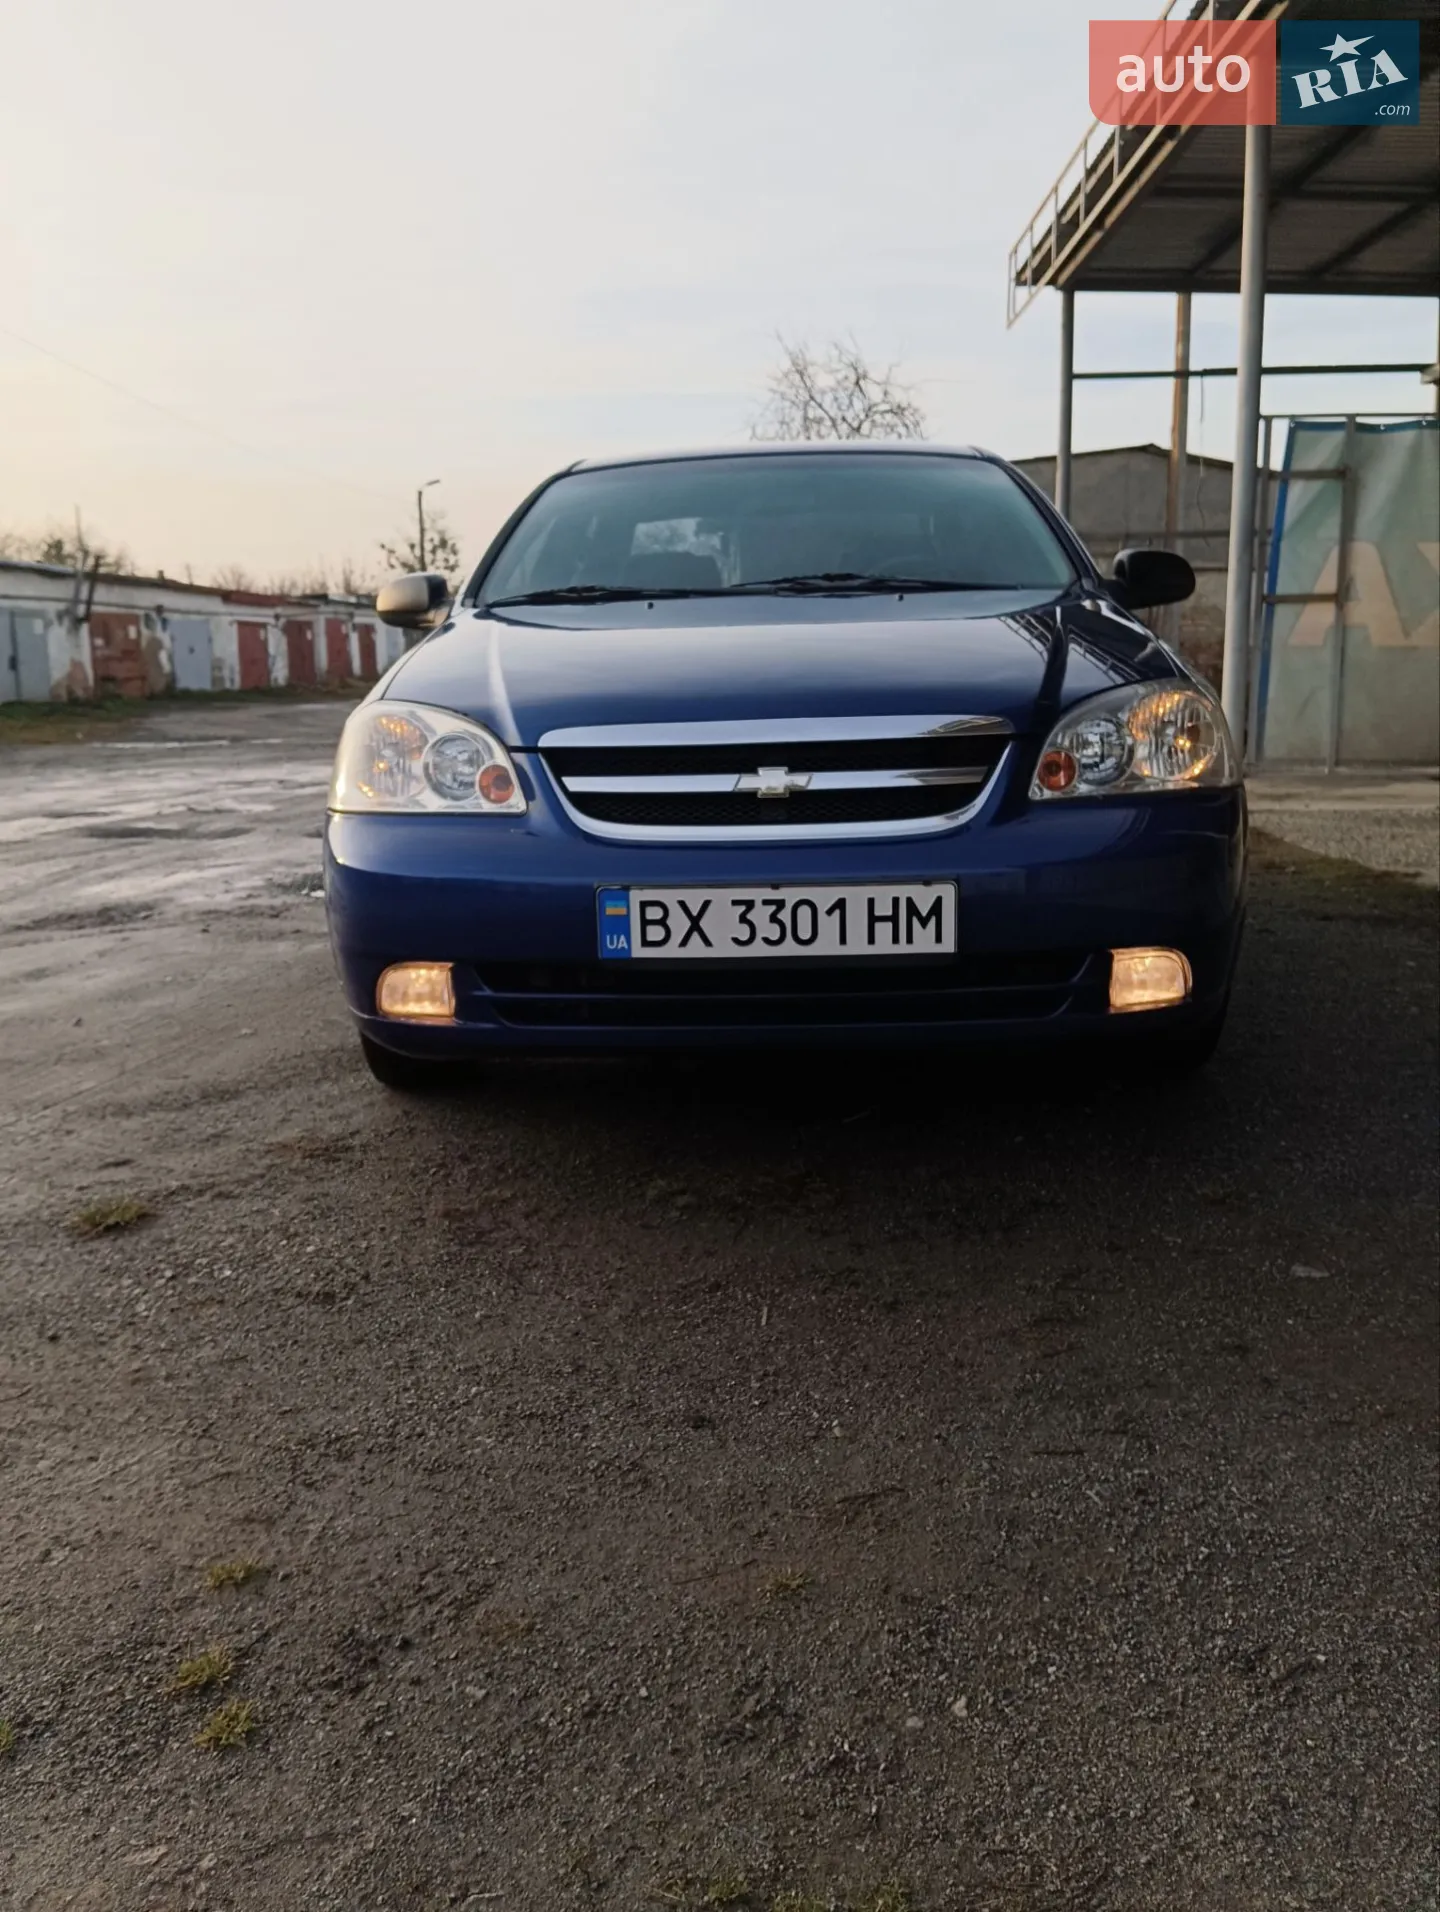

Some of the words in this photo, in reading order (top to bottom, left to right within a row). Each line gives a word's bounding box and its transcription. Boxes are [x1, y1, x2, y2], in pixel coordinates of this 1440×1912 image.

[639, 899, 714, 948] BX
[730, 897, 847, 946] 3301
[867, 895, 943, 945] HM
[606, 934, 628, 949] UA
